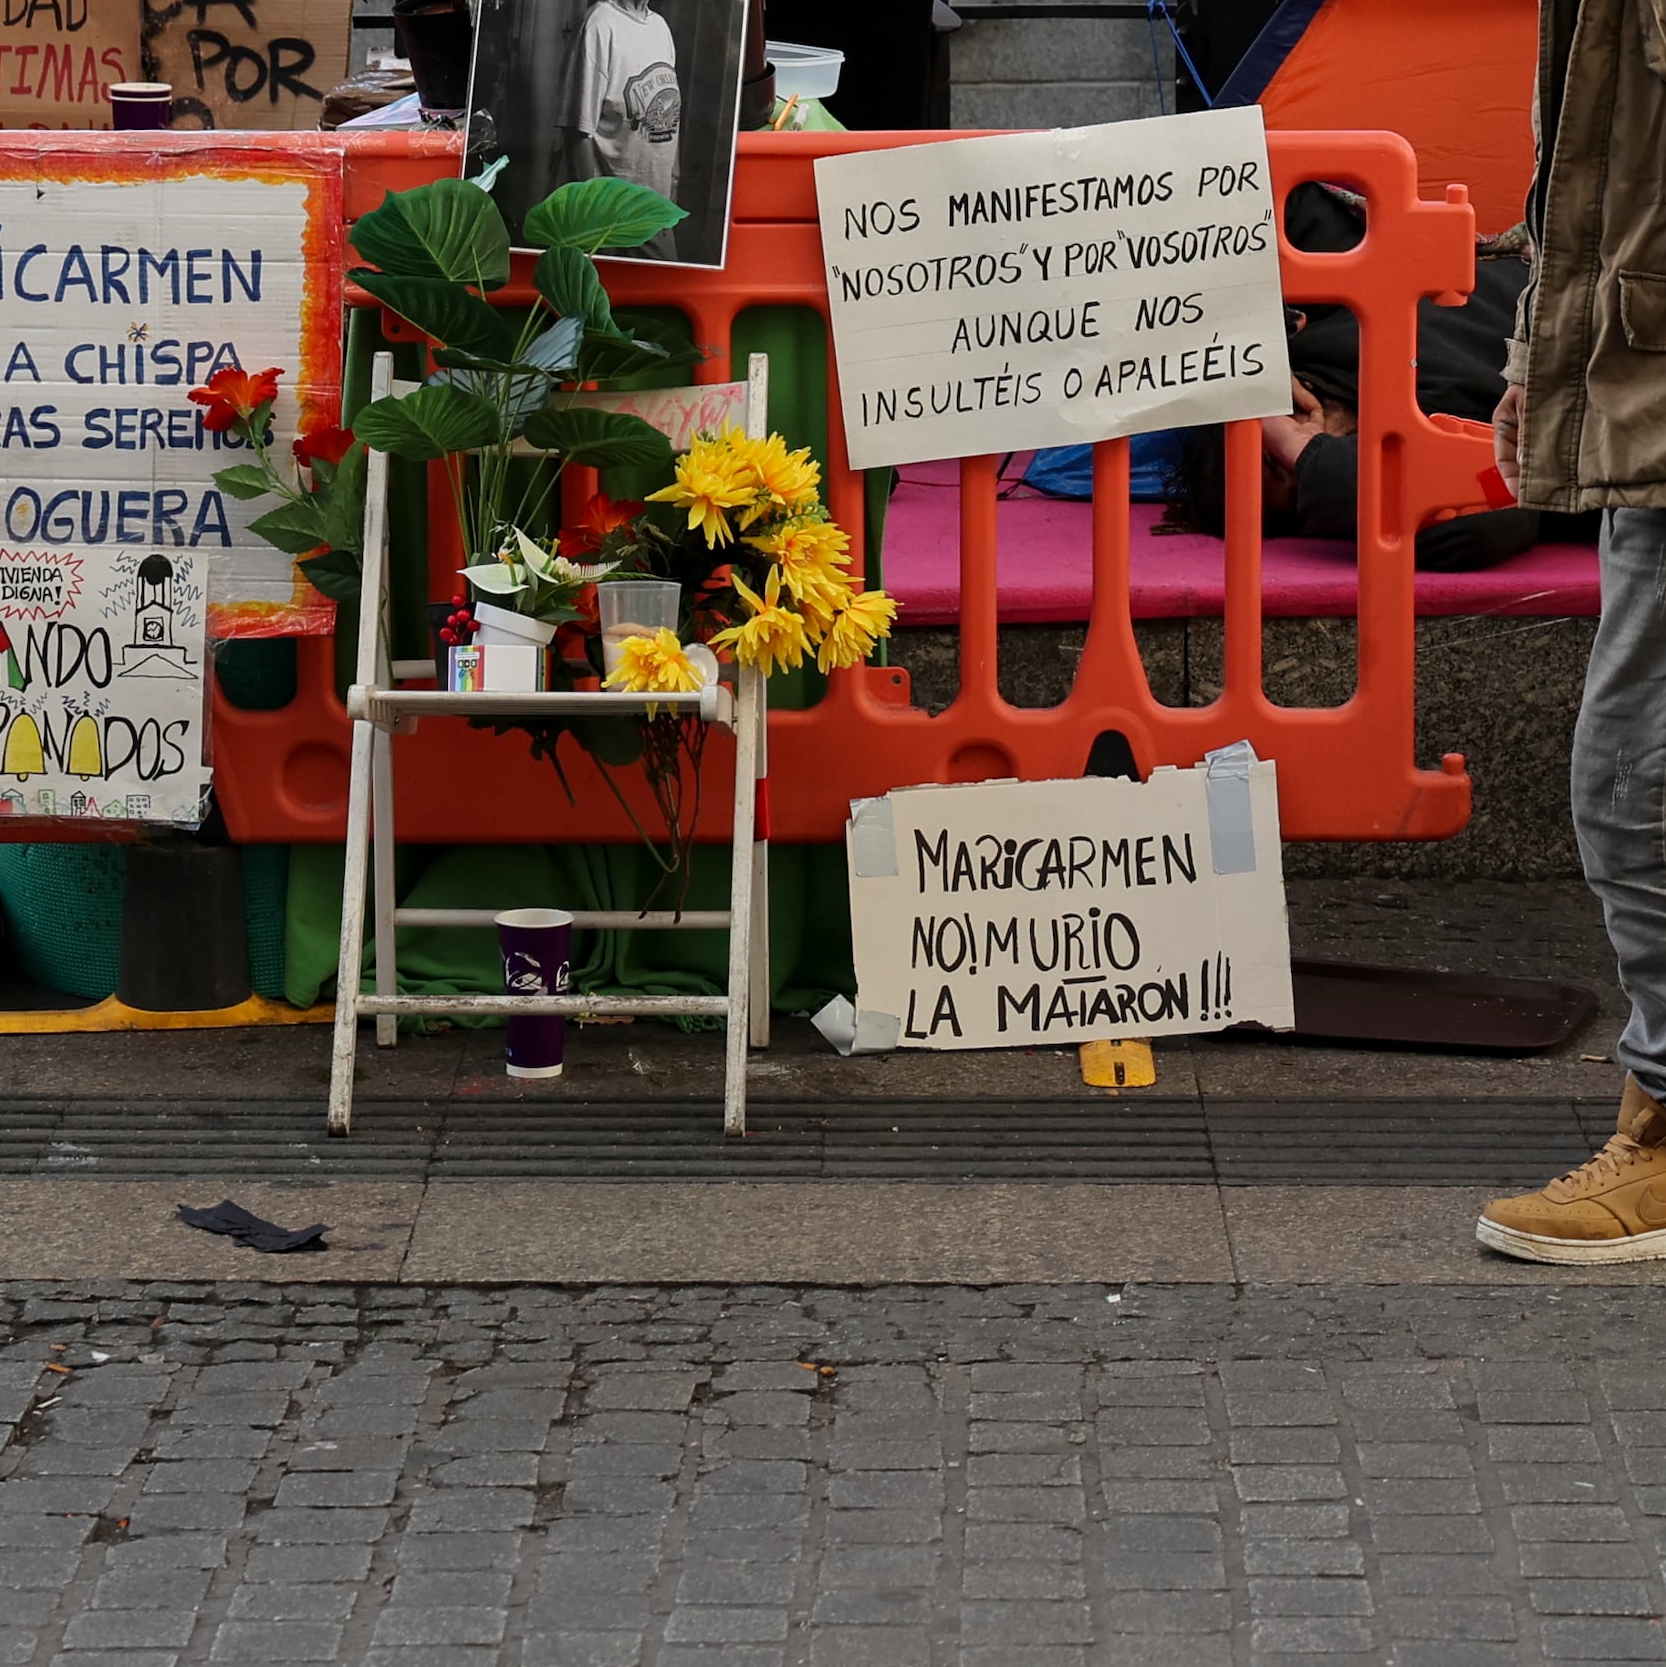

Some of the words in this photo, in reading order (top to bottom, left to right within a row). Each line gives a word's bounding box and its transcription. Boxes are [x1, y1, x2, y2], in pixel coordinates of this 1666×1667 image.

[189, 31, 326, 105] POR
[844, 199, 921, 240] NOS
[948, 171, 1174, 228] MANIFESTAMOS
[1197, 162, 1260, 199] POR
[1033, 245, 1053, 282] Y
[1065, 240, 1116, 278] POR
[951, 301, 1101, 354] AUNQUE
[1135, 293, 1204, 332] NOS
[861, 362, 1043, 427] INSULTÉIS
[1063, 367, 1083, 399] O
[1094, 332, 1264, 398] APALEÉIS
[1, 585, 62, 607] DIGNA!
[904, 985, 963, 1039] LA
